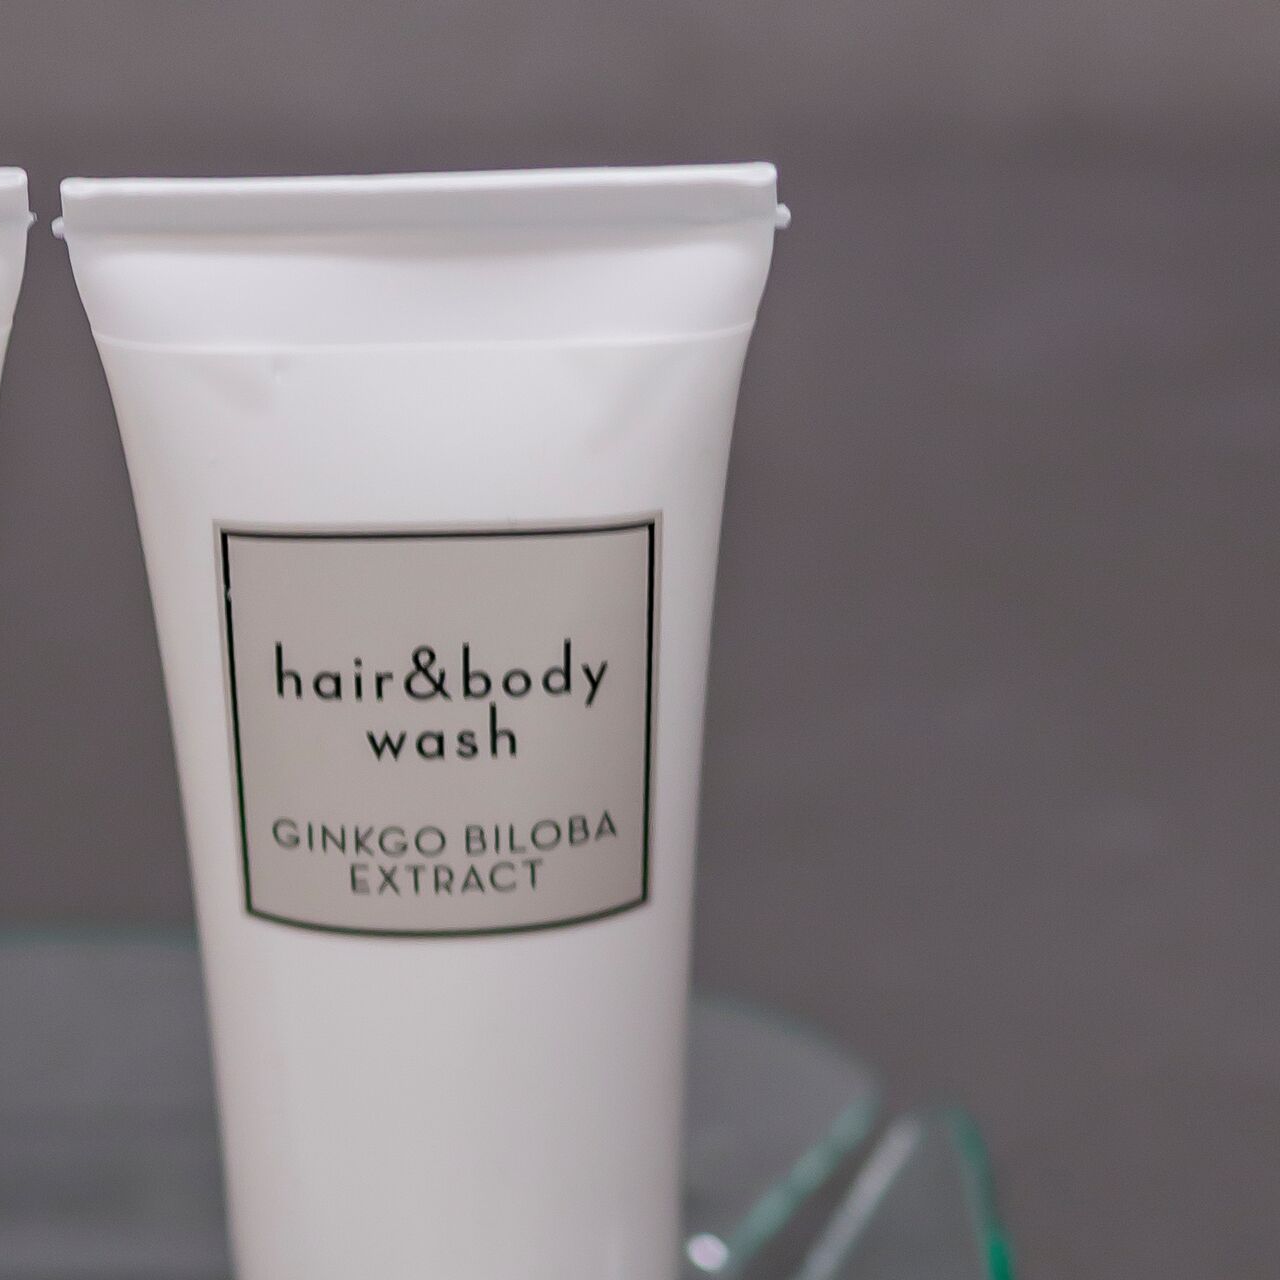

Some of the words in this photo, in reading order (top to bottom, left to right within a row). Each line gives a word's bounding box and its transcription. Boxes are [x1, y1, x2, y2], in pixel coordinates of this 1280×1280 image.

[275, 638, 608, 707] hair&body
[366, 702, 517, 760] wash
[272, 818, 447, 857] GINKGO
[465, 810, 617, 854] BILOBA
[351, 858, 544, 895] EXTRACT
